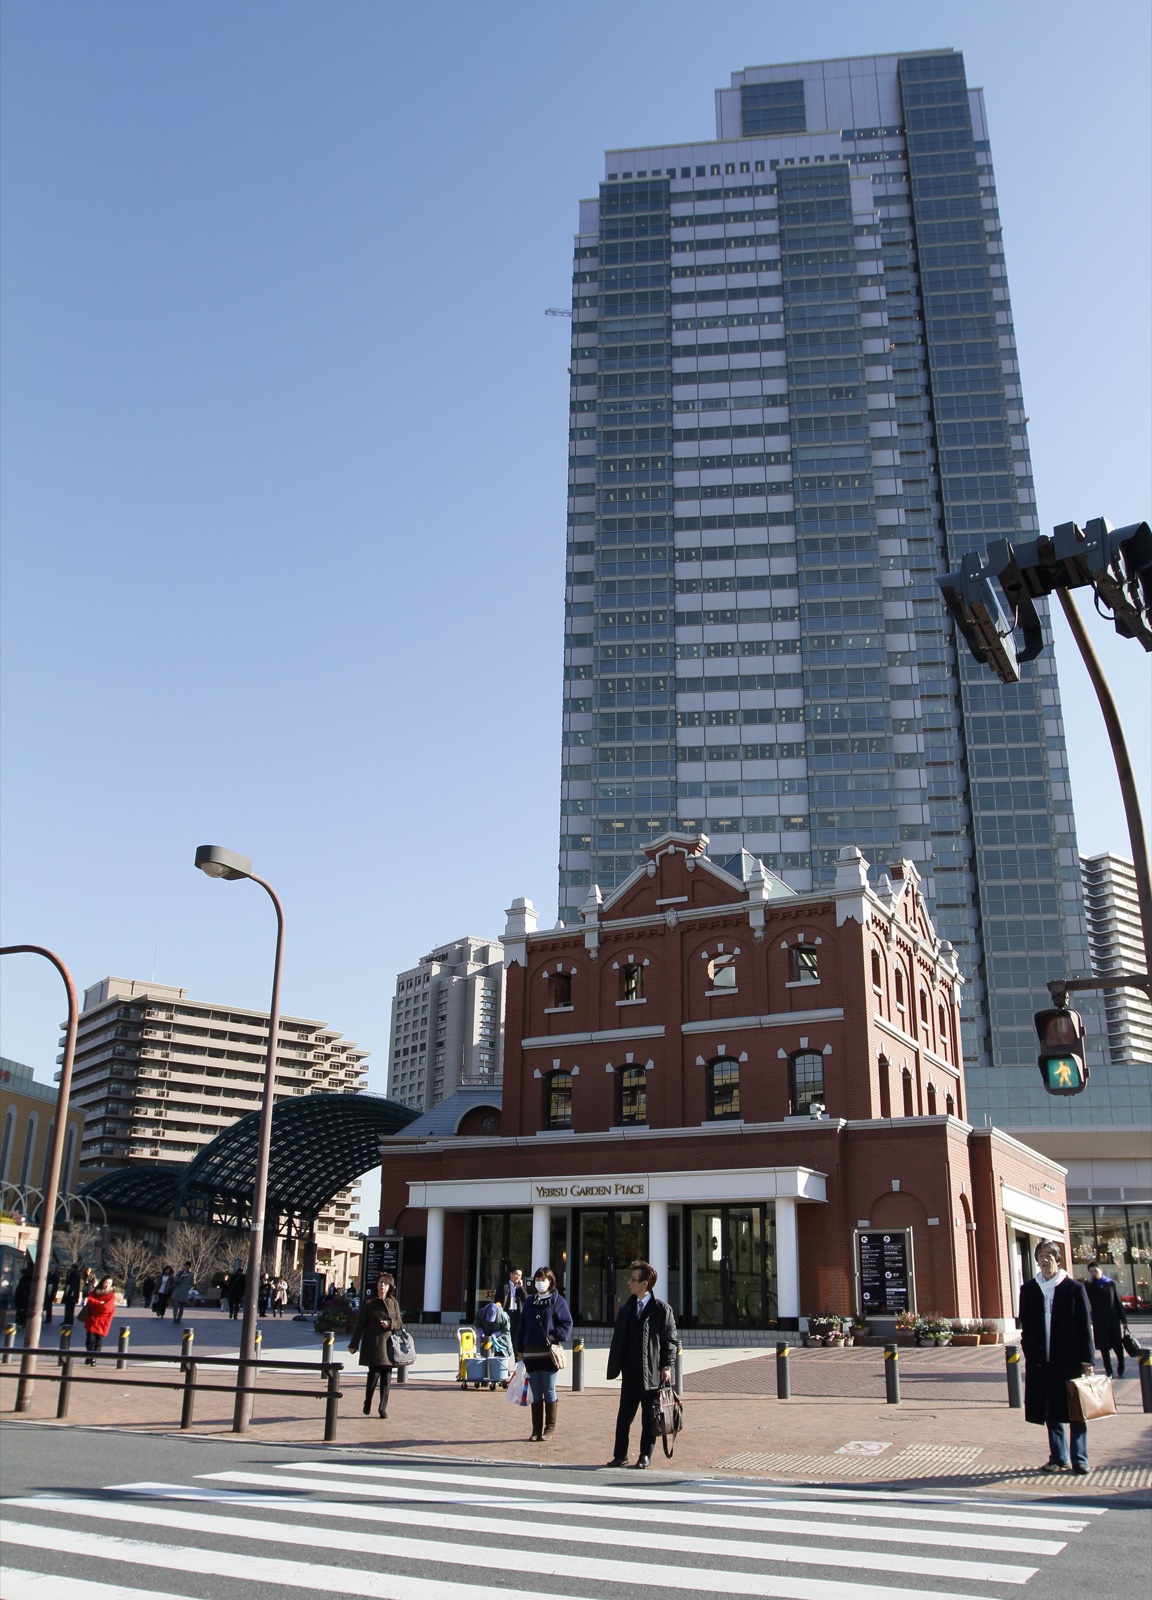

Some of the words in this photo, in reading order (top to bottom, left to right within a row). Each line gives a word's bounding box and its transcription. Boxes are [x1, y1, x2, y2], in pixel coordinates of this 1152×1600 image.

[535, 1186, 568, 1198] YEBISU
[570, 1185, 612, 1197] GARDEN
[614, 1183, 645, 1195] PLACE
